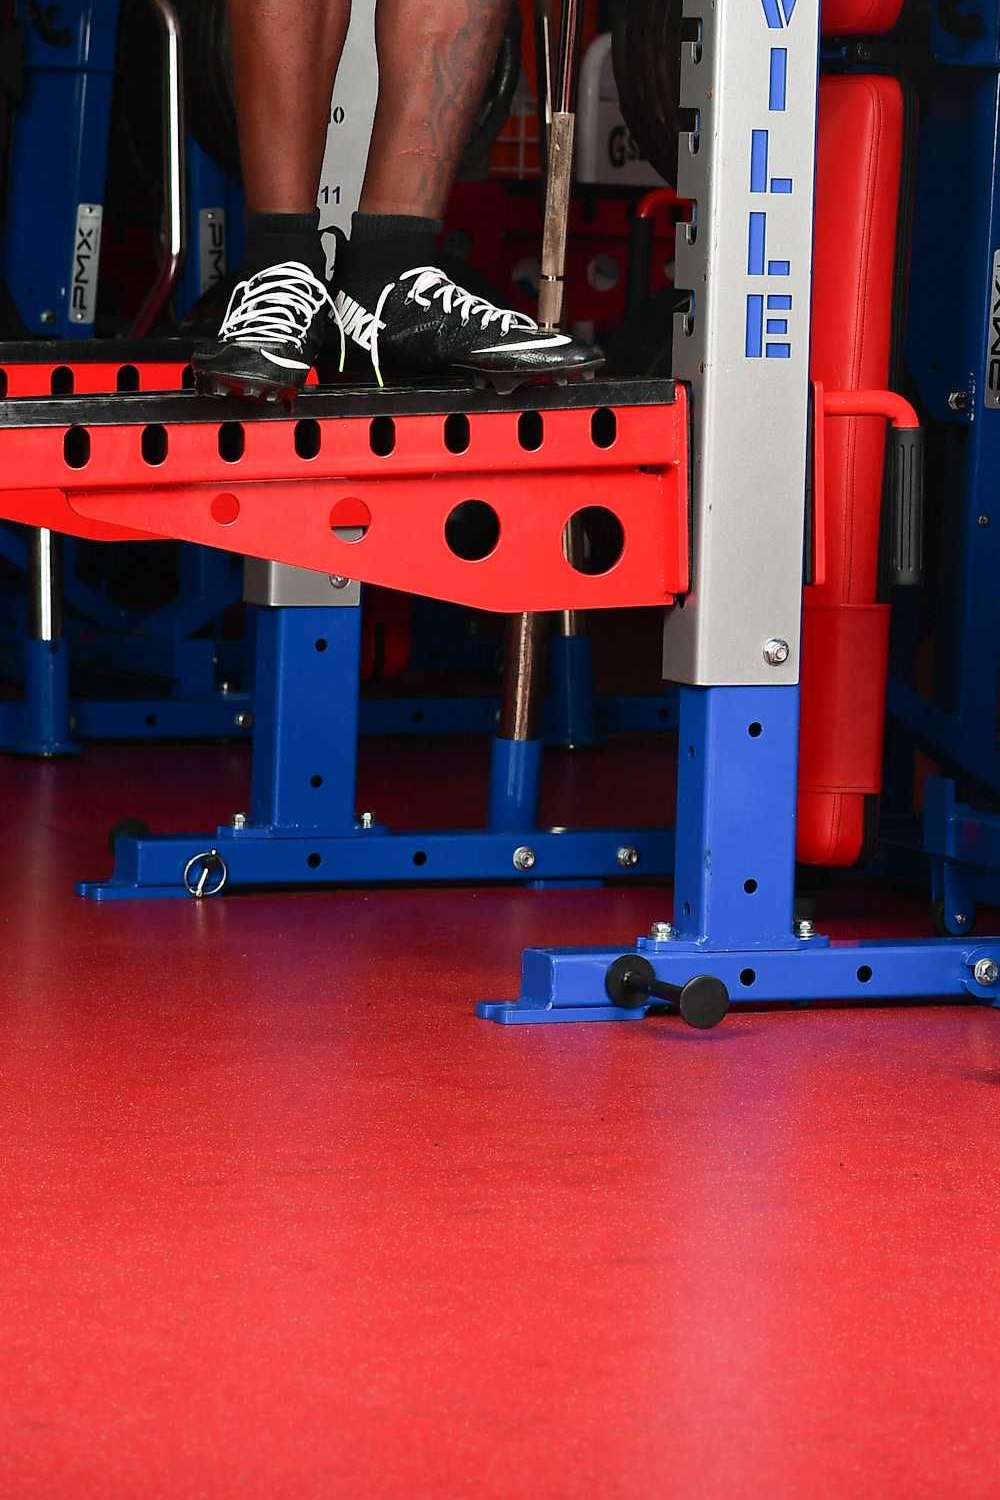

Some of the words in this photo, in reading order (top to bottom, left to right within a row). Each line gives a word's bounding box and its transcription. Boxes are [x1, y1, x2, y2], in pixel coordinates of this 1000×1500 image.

[320, 185, 341, 205] 11
[72, 227, 94, 310] PMX
[330, 289, 387, 352] NIKE
